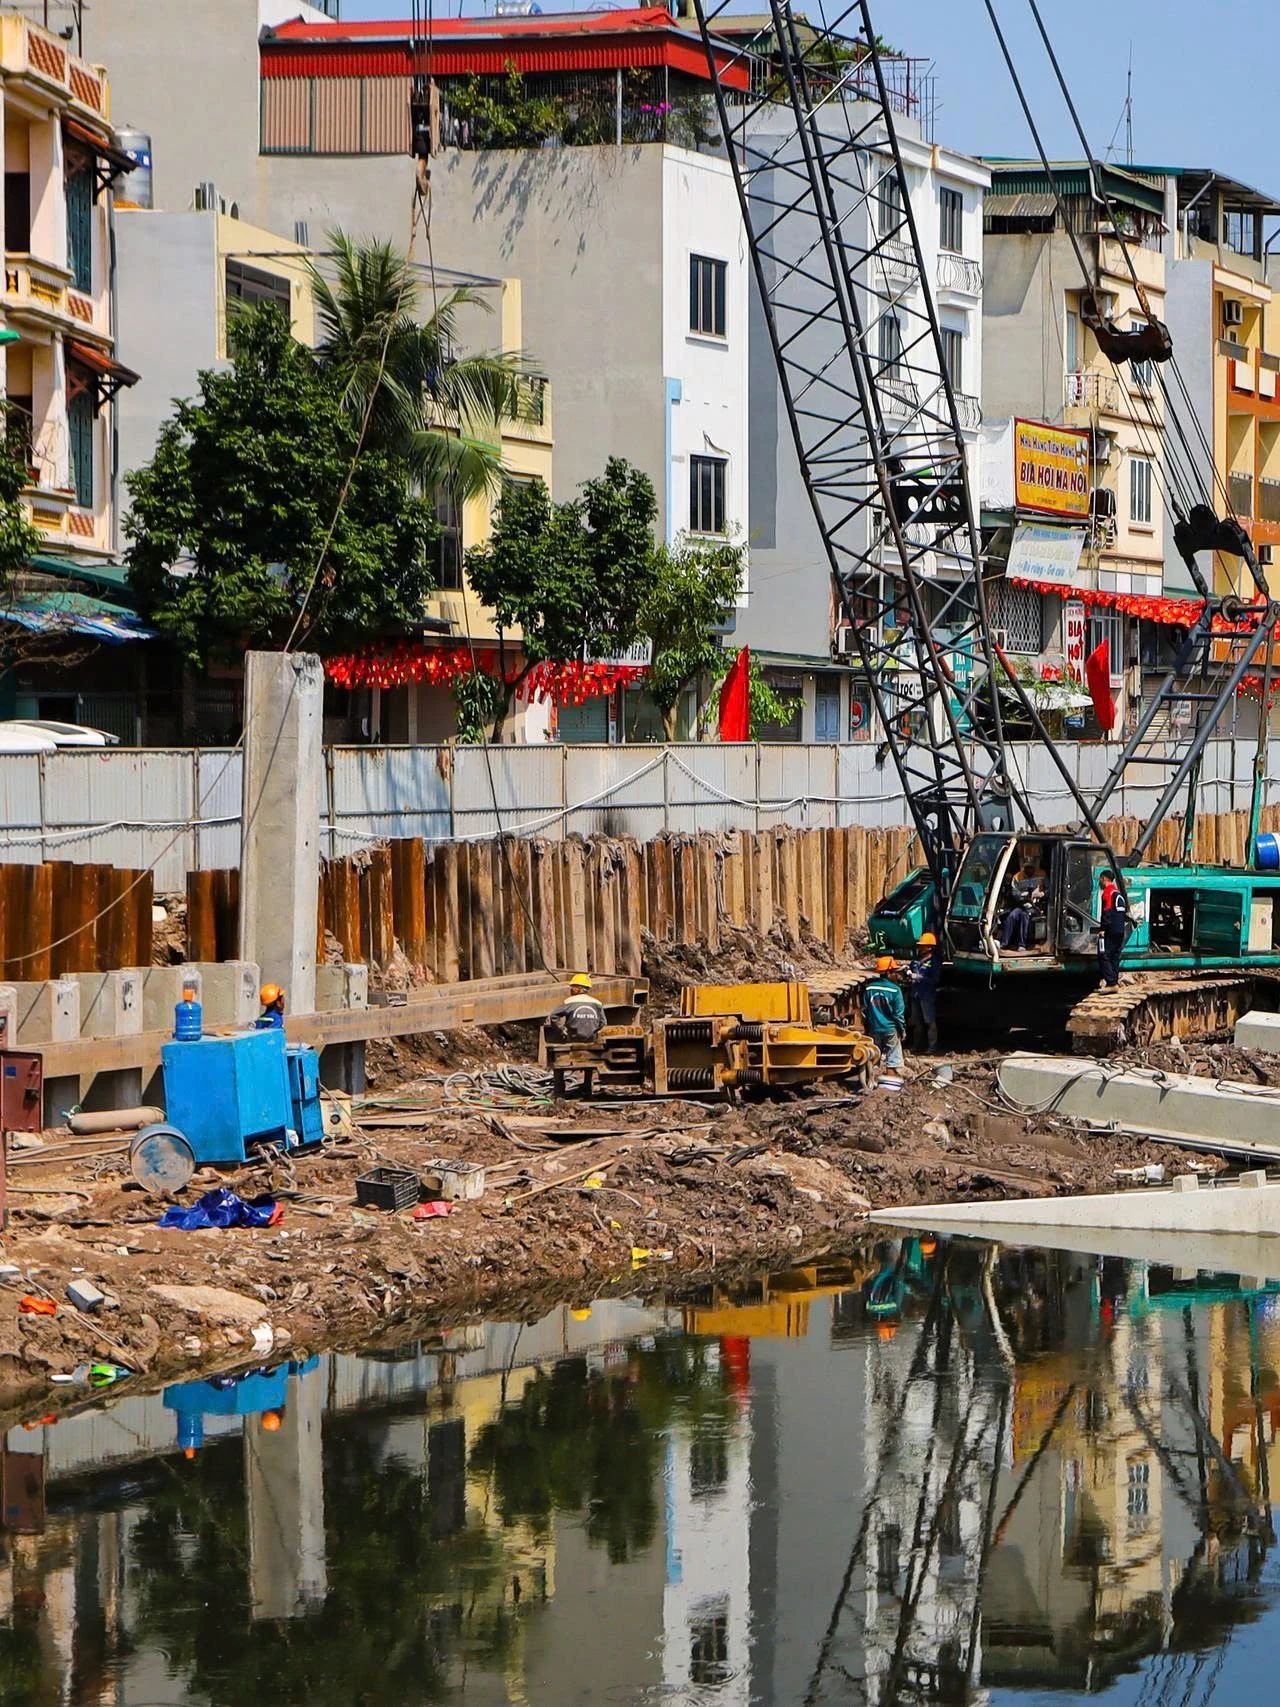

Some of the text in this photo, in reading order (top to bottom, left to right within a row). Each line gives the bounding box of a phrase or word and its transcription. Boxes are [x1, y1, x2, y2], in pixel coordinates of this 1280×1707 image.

[1038, 464, 1054, 487] HƠI
[1070, 467, 1087, 498] NỘI
[1068, 620, 1083, 638] BIA
